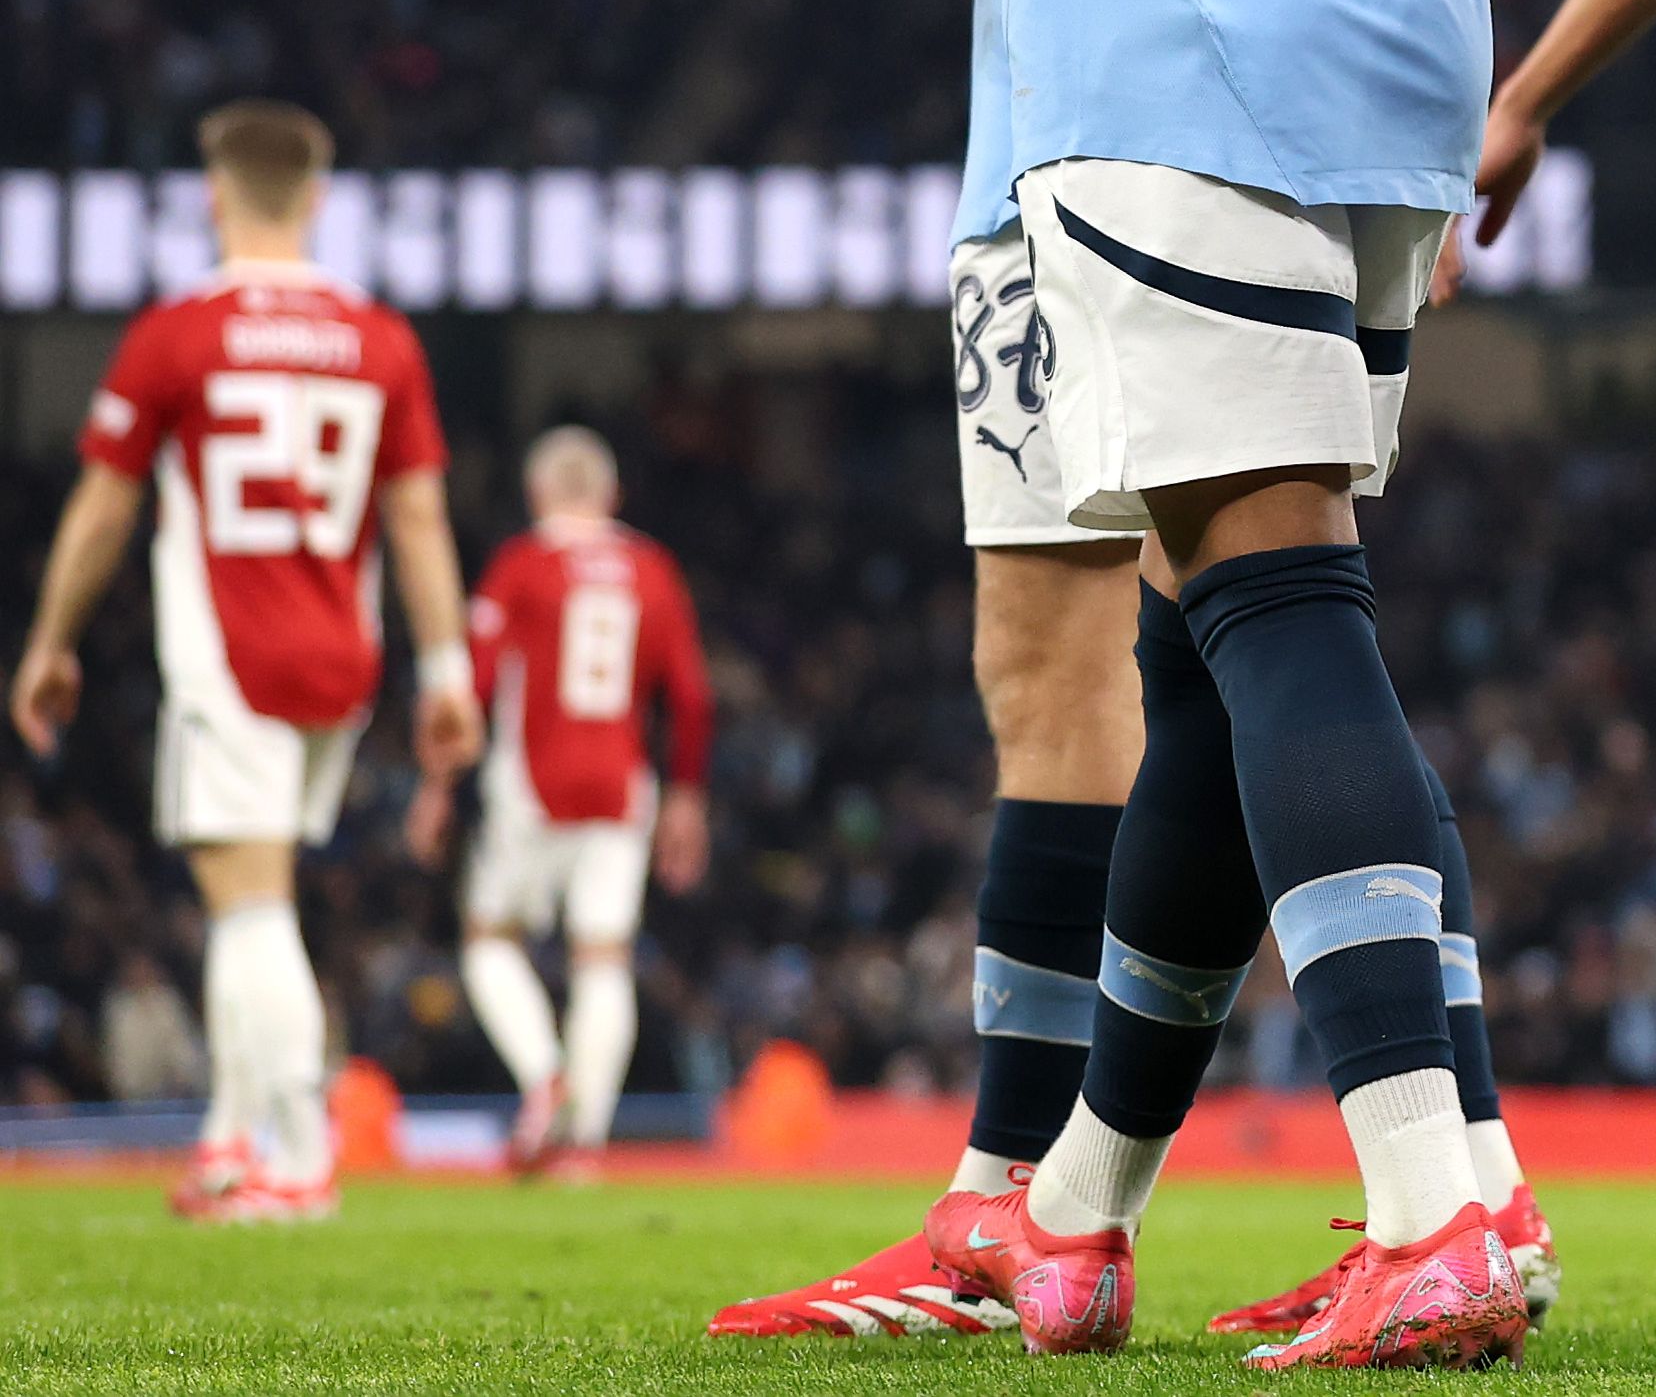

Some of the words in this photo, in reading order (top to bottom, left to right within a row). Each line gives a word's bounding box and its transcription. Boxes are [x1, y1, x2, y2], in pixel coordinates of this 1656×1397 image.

[955, 273, 1046, 414] 87
[203, 372, 385, 559] 29
[557, 582, 643, 719] 8
